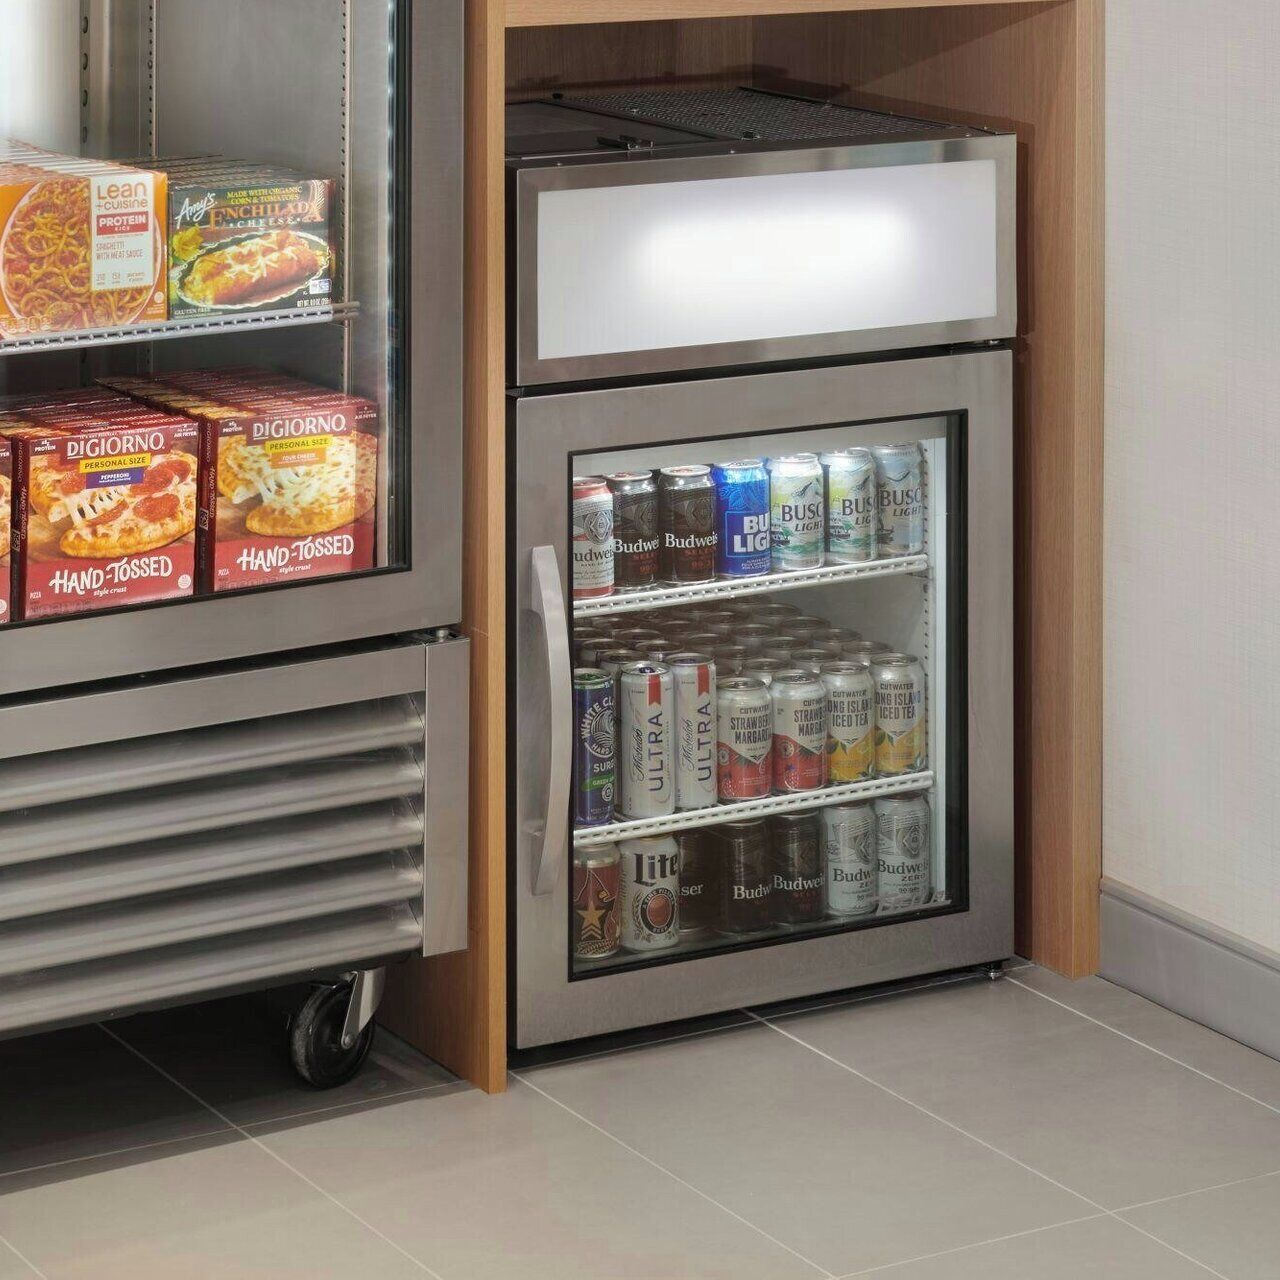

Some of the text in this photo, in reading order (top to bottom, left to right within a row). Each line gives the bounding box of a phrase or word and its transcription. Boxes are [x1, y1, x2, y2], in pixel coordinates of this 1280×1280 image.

[97, 182, 147, 200] Lean
[175, 192, 216, 228] Amy's
[98, 215, 146, 227] PROTEIN
[96, 241, 125, 252] SPAGHETTI
[96, 248, 143, 260] WITH MEAT SAUCE
[84, 456, 147, 470] PERSONAL SIZE
[100, 472, 130, 482] PEPPERONI
[743, 514, 770, 534] BU
[49, 555, 174, 595] HAND-TOSSED
[93, 586, 128, 597] style crust
[879, 682, 914, 692] CUTWATER
[879, 705, 916, 721] ICED TEA
[697, 701, 712, 782] ULTRA
[647, 710, 663, 792] ULTRA
[633, 853, 678, 886] Lite
